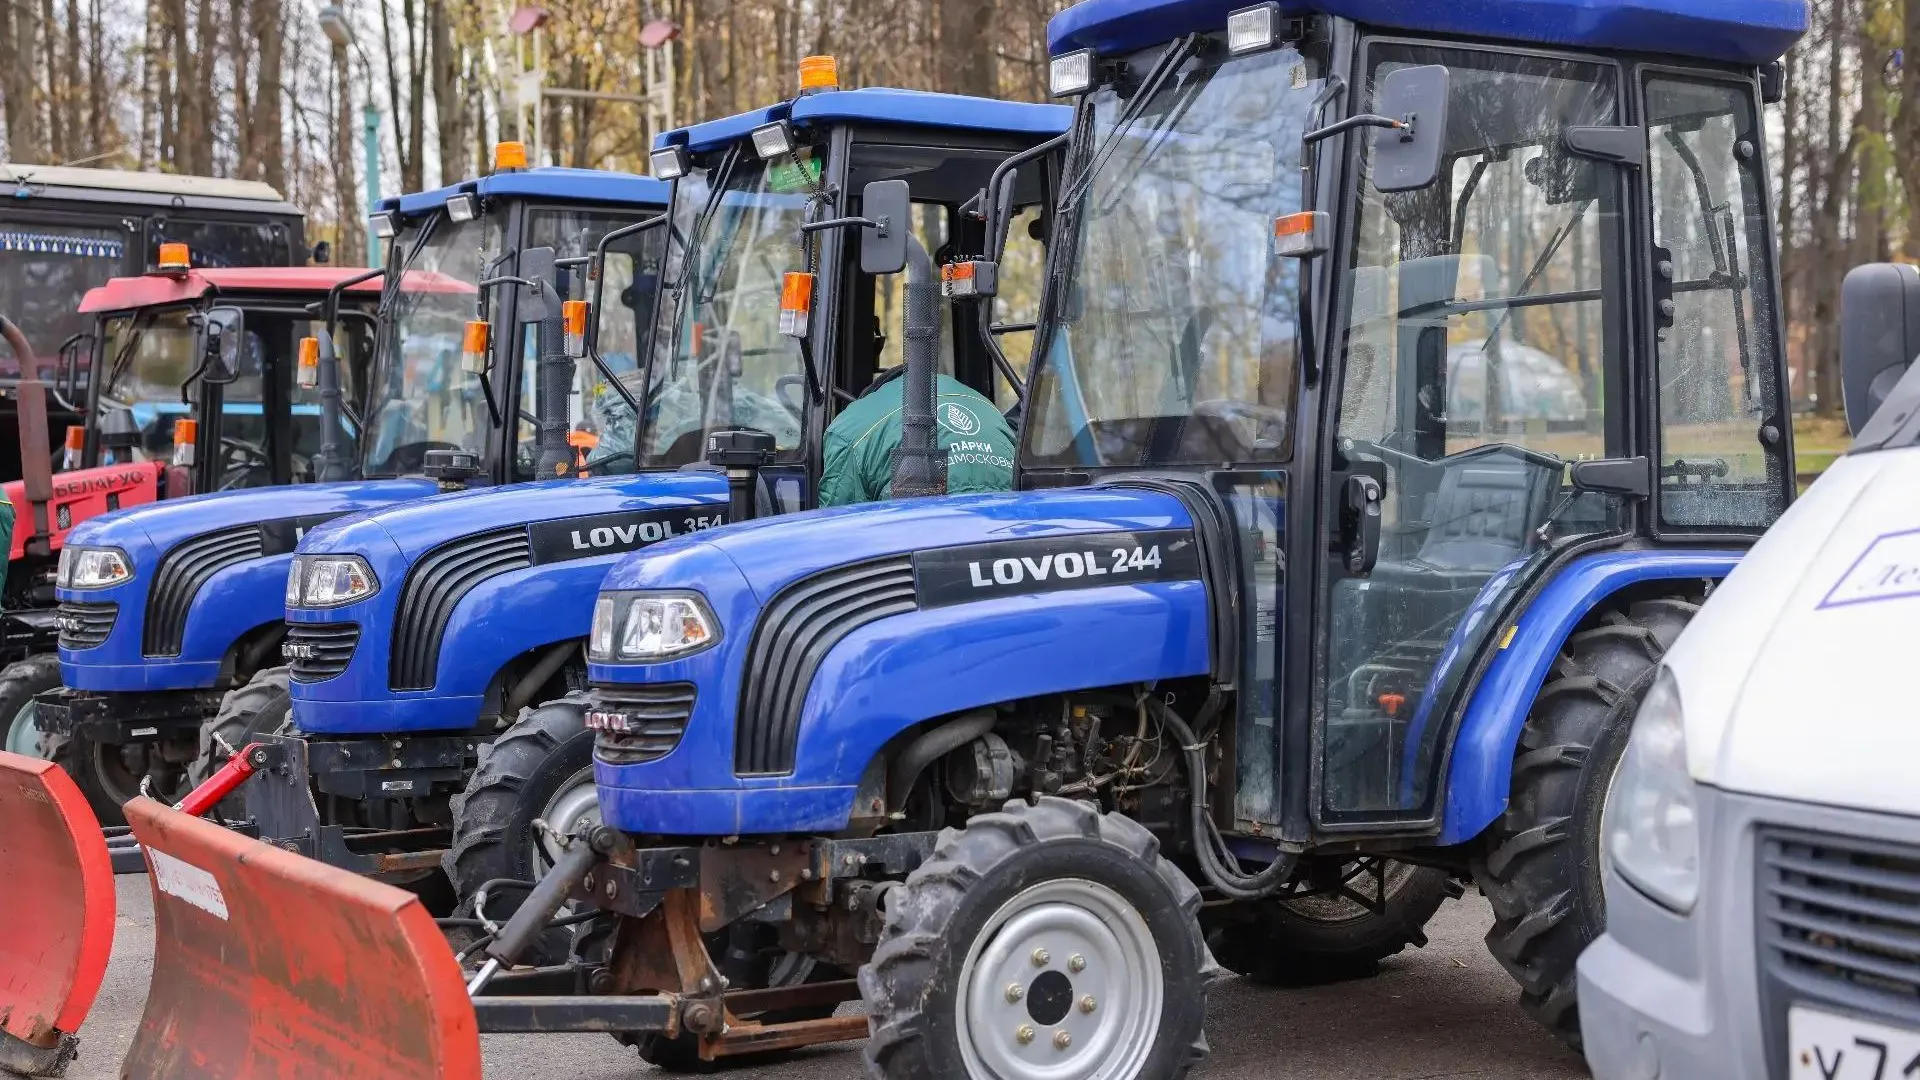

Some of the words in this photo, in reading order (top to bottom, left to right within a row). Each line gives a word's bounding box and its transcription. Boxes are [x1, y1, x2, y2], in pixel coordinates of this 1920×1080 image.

[949, 440, 993, 453] ПАРКИ
[570, 521, 681, 550] LOVOL
[683, 514, 722, 534] 354
[968, 551, 1108, 588] LOVOL
[1111, 544, 1162, 574] 244
[281, 644, 314, 658] LOVOL
[584, 712, 632, 730] LOVOL
[1813, 1036, 1920, 1080] У7
